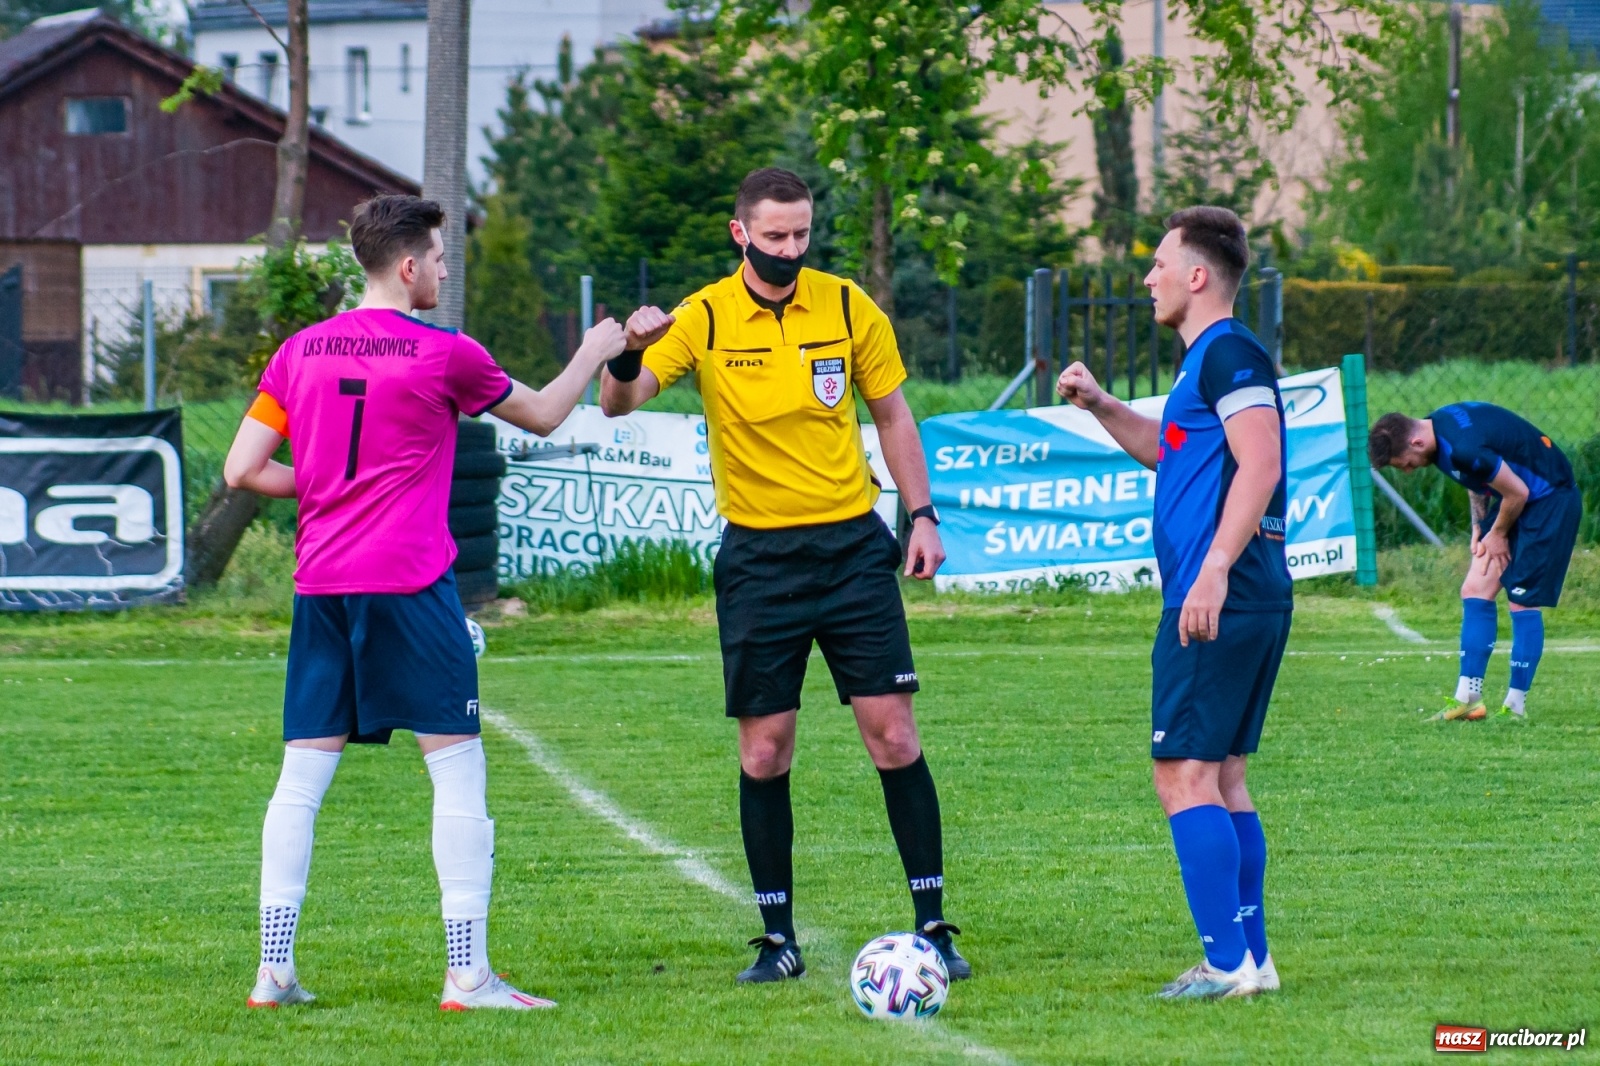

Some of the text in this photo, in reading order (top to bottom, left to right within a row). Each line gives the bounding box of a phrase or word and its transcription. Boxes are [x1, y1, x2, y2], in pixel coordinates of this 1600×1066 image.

[303, 334, 420, 357] LKS KRZYŻANOWICE
[338, 377, 367, 480] 7
[638, 451, 672, 468] Bau
[934, 441, 1051, 472] SZYBKI
[497, 472, 722, 533] SZUKAM
[959, 469, 1157, 510] INTERNET
